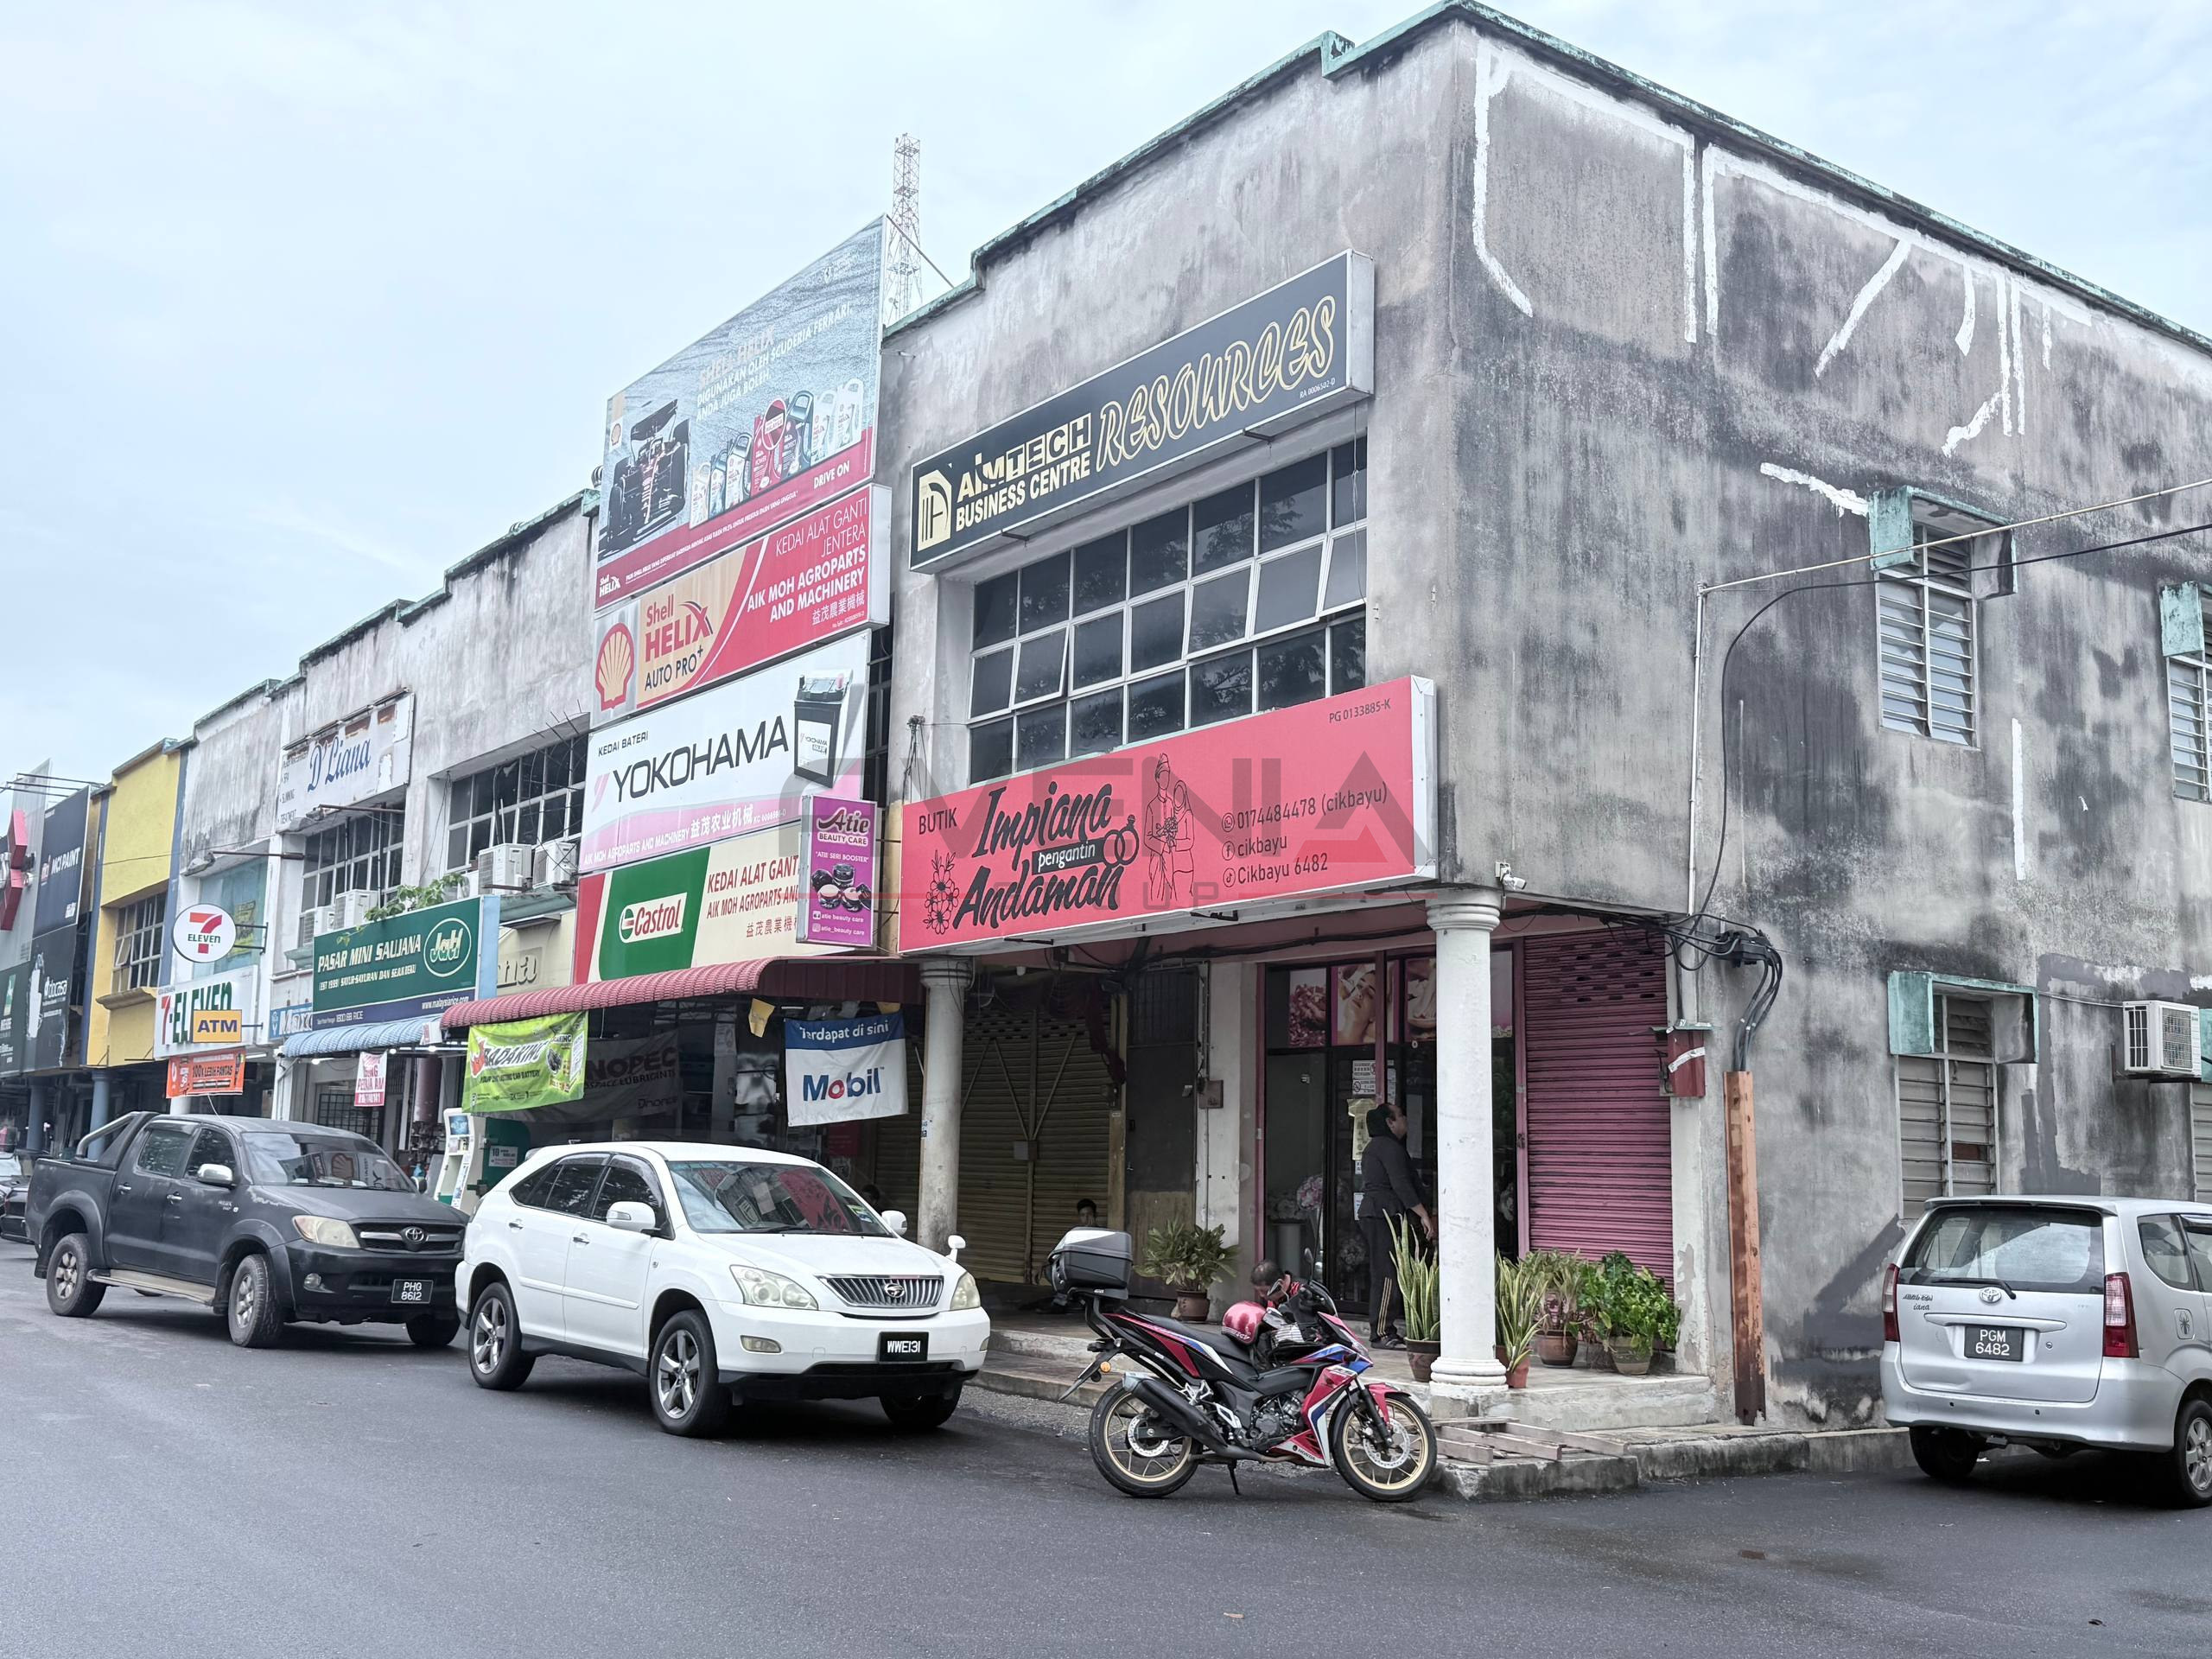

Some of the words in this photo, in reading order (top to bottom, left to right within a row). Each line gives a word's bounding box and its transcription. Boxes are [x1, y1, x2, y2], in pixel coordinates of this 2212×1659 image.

[697, 372, 747, 404] DIGUNAKAN
[747, 355, 769, 375] OLEH
[771, 332, 811, 361] SCUDERIA
[1096, 295, 1337, 474] RESOURCES
[1300, 390, 1307, 399] RA
[696, 404, 718, 423] ANDA
[719, 391, 741, 410] JUGA
[814, 469, 835, 489] DRIVE
[837, 461, 850, 477] ON
[956, 480, 1026, 532] BUSINESS
[1030, 450, 1090, 499] CENTRE
[776, 529, 804, 556] KEDAI
[806, 515, 830, 543] ALAT
[833, 498, 867, 529] GANTI
[821, 522, 866, 559] JENTERA
[599, 576, 621, 598] HELIX
[601, 575, 609, 586] Shell
[747, 588, 766, 613] AIK
[768, 575, 795, 602] MOH
[798, 543, 866, 590] AGROPARTS
[770, 598, 795, 623] AND
[798, 566, 866, 612] MACHINERY
[646, 594, 674, 627] Shell
[645, 601, 713, 663] HELIX
[645, 664, 672, 691] AUTO
[1328, 710, 1341, 724] PG
[1343, 698, 1390, 721] 0133885-K
[598, 745, 620, 757] KEDAI
[621, 731, 649, 750] BATERI
[613, 715, 789, 803] YOKOHAMA
[1237, 797, 1316, 830] 0174484478
[1321, 781, 1387, 816] (cikbayu)
[584, 854, 594, 865] AIK
[607, 843, 640, 860] AGROPARTS
[642, 839, 654, 850] AND
[655, 828, 690, 849] MACHINERY
[690, 804, 753, 839] 益茂农业机械
[817, 807, 869, 835] Atie
[918, 807, 957, 835] BUTIK
[972, 781, 1112, 871] Impiana
[819, 833, 846, 844] BEAUTY
[848, 835, 867, 845] CARE
[1237, 836, 1287, 857] cikbayu
[61, 848, 80, 868] PAINT
[1038, 841, 1096, 873] pengantin
[1237, 862, 1289, 884] Cikbayu
[1294, 853, 1328, 875] 6482
[708, 871, 737, 893] KEDAI
[740, 862, 766, 887] ALAT
[769, 855, 799, 880] GANT
[707, 901, 719, 918] AIK
[721, 898, 737, 916] MOH
[739, 892, 782, 912] AGROPARTS
[952, 859, 1124, 930] Andaman
[635, 899, 682, 937] Castrol
[832, 913, 851, 923] beauty
[318, 950, 347, 973] PASAR
[349, 944, 373, 966] MINI
[378, 969, 391, 981] DAN
[197, 1020, 238, 1033] ATM
[799, 1026, 849, 1043] Terdapat
[853, 1023, 863, 1037] di
[866, 1020, 889, 1035] sini
[587, 1046, 678, 1078] NOPEC
[803, 1068, 880, 1102] Mobil
[401, 1291, 422, 1300] 8612
[1975, 1342, 2010, 1356] 6482
[1980, 1329, 2006, 1343] PGM
[1297, 1449, 1315, 1461] HONDA
